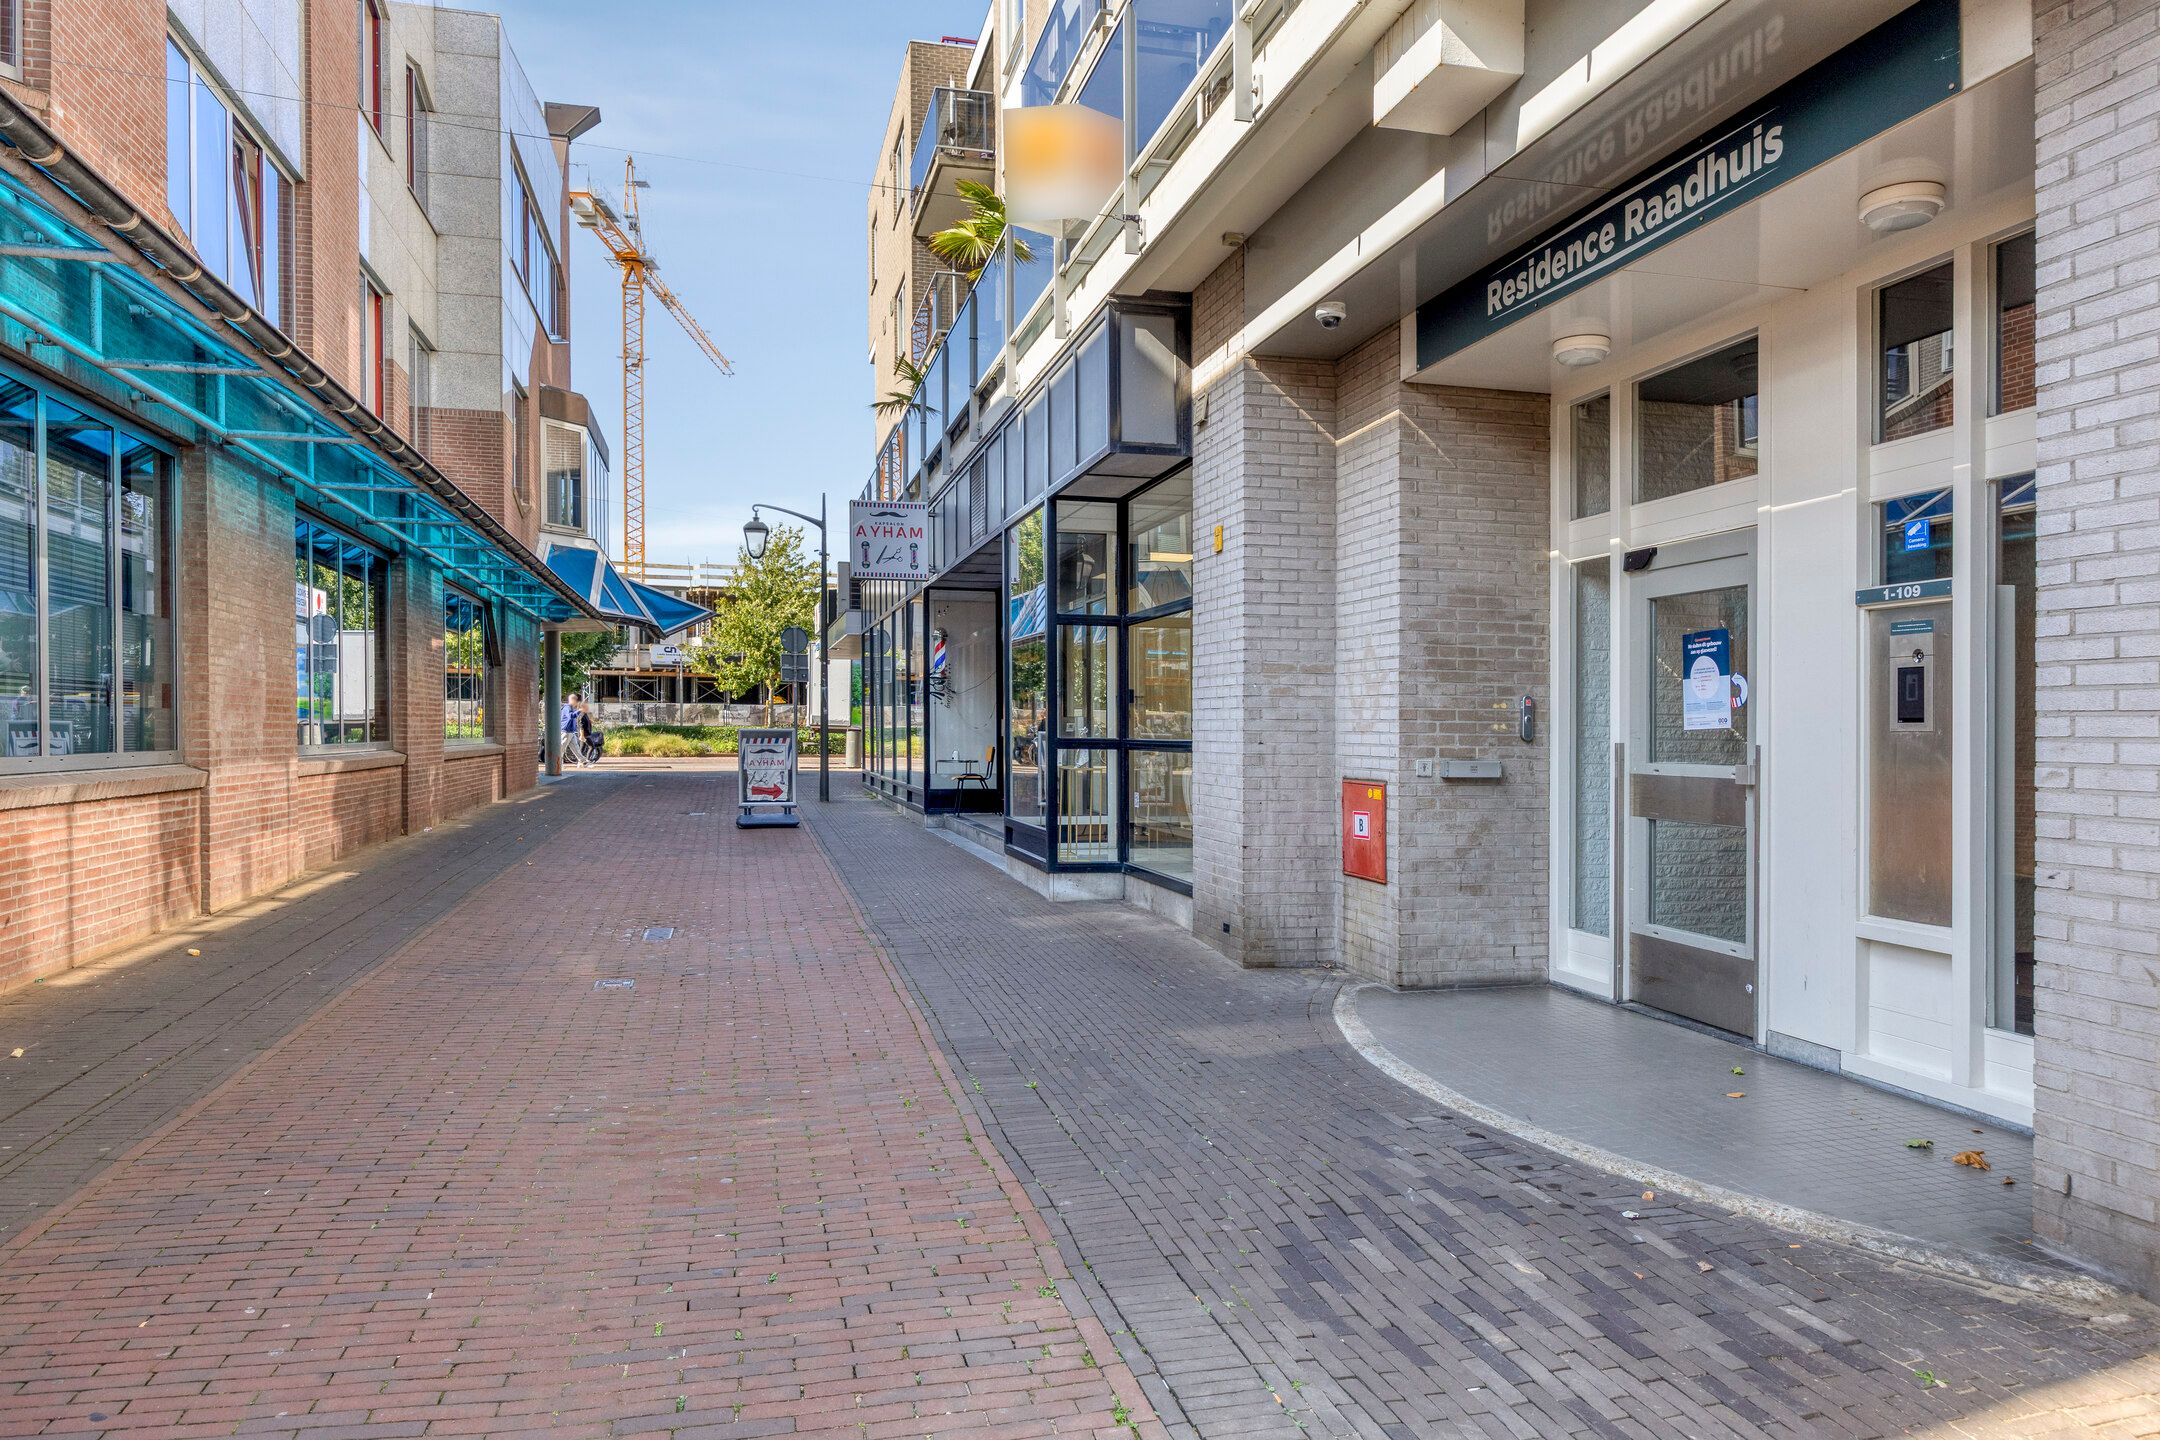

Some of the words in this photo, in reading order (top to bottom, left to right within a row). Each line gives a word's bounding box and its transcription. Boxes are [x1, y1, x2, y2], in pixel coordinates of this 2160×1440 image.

[1486, 221, 1615, 317] Residence
[1624, 122, 1785, 238] Raadhuis
[855, 525, 923, 539] AYHAM
[1883, 584, 1921, 600] 1-109
[749, 759, 785, 767] AYHAM
[1358, 818, 1364, 832] B
